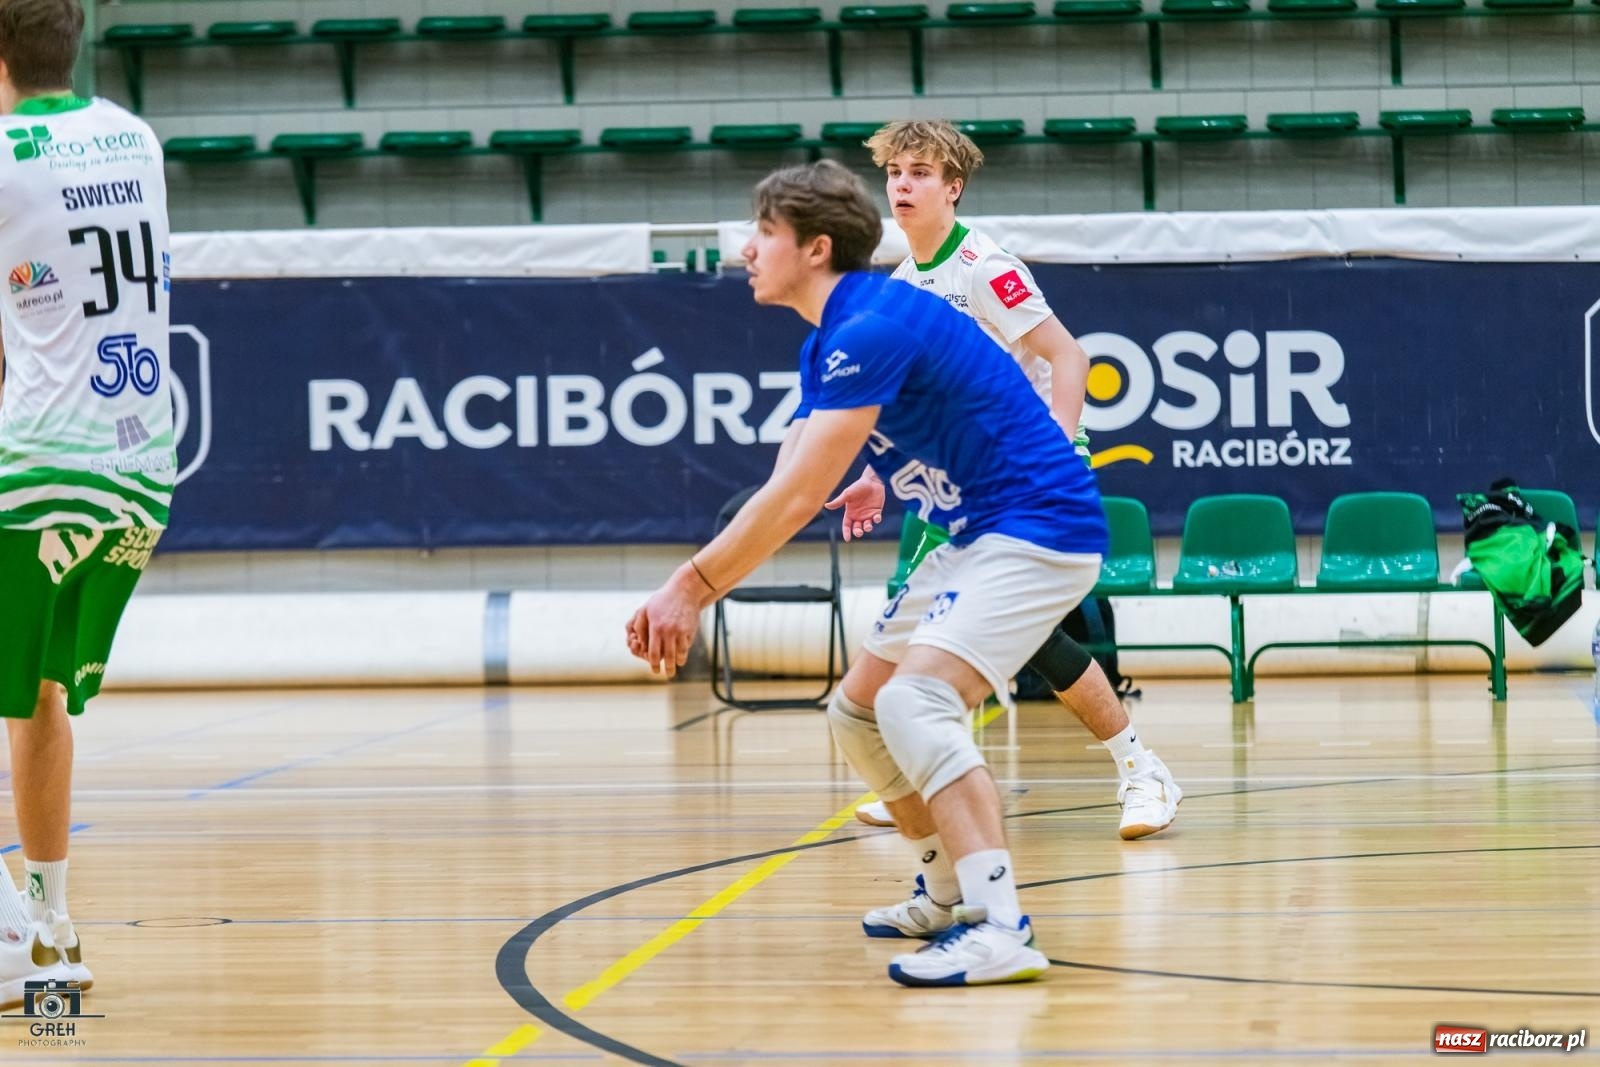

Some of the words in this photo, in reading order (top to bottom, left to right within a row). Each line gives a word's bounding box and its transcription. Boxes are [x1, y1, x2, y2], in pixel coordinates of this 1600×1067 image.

[62, 179, 143, 212] SIWECKI
[68, 220, 158, 318] 34
[308, 346, 802, 451] RACIBÓRZ
[1075, 329, 1352, 432] OSiR
[1172, 430, 1352, 468] RACIBÓRZ
